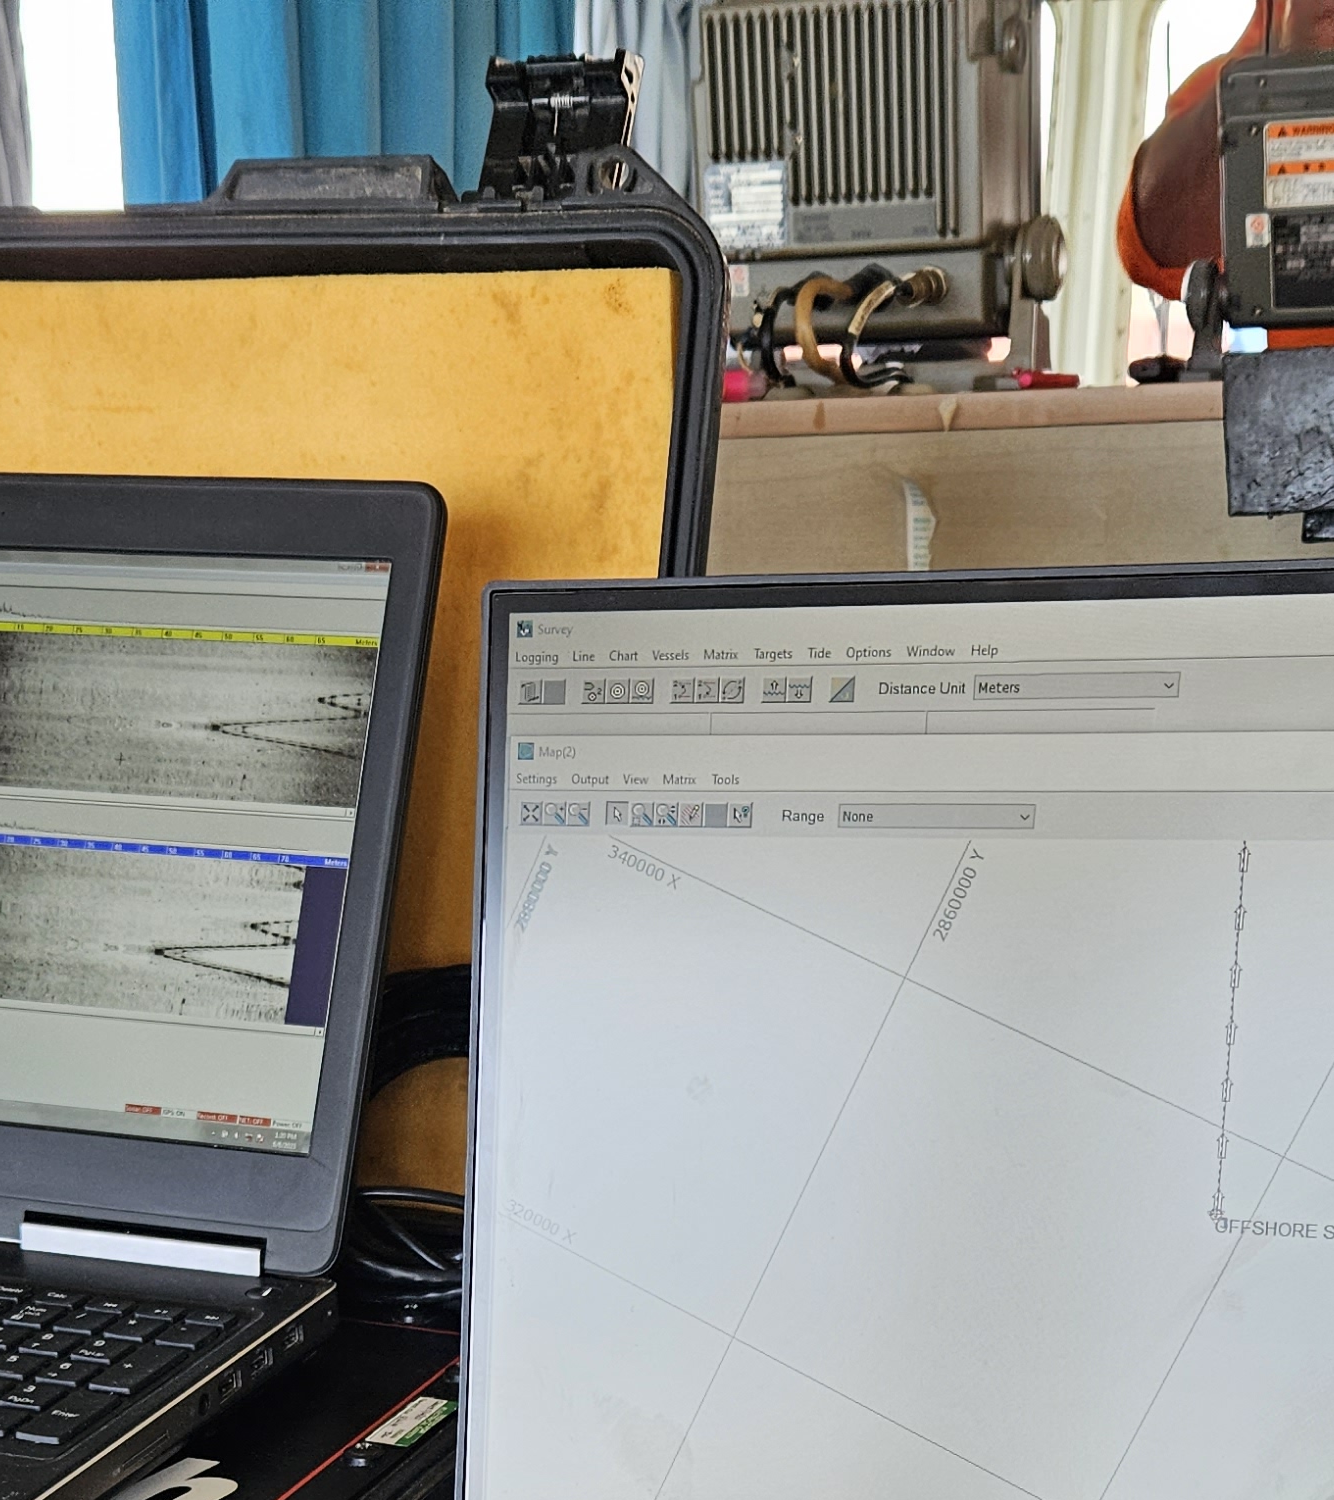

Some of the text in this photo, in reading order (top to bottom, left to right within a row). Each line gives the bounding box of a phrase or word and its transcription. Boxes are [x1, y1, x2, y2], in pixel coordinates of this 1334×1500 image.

[538, 624, 573, 636] Survey
[515, 645, 999, 665] Logging Line Chart Vessels Matrix Targets Tide Options Window Help
[879, 681, 1020, 695] Distance Unit Meters
[516, 774, 740, 786] Settings Output View Matrix Tools
[782, 809, 874, 824] Range None
[607, 844, 682, 890] 340000 X
[933, 848, 985, 942] 2860000 Y
[1215, 1218, 1316, 1241] OFFSHORE
